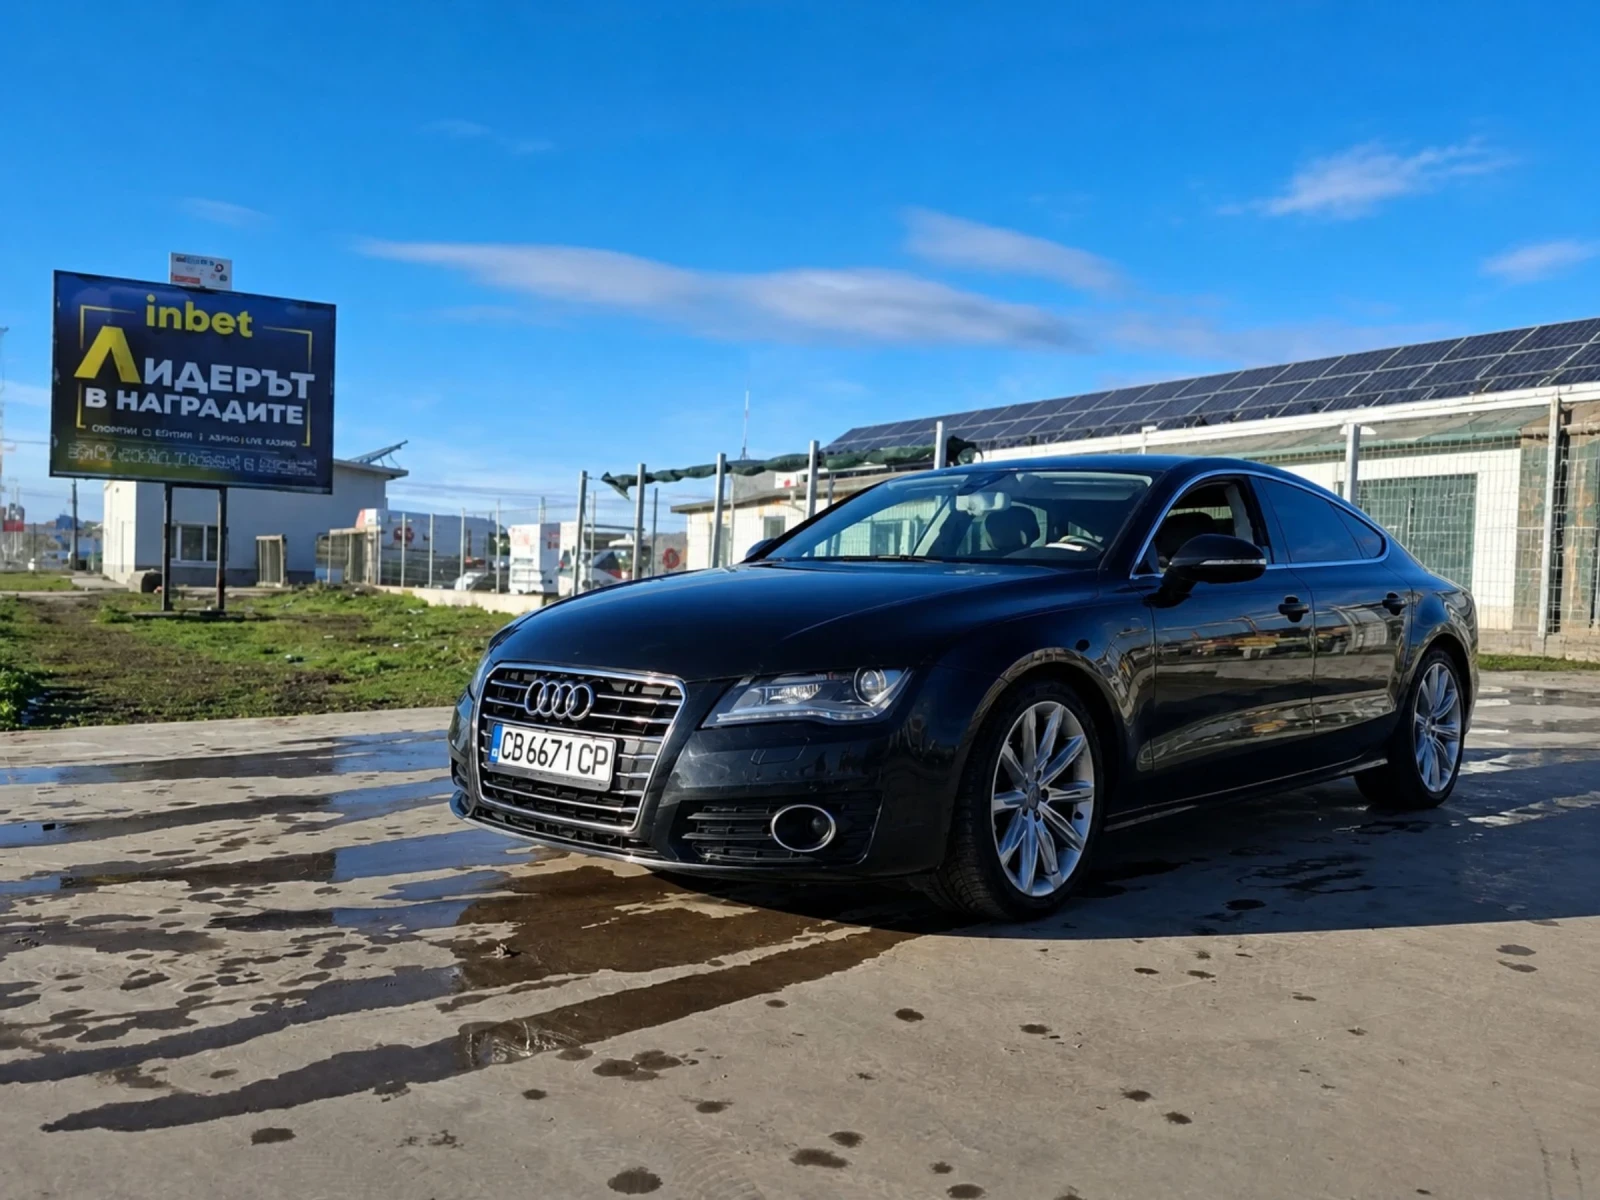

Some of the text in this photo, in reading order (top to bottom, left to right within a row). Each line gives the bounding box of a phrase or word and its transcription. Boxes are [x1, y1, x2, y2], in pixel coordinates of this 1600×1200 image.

[146, 294, 253, 338] inbet
[73, 325, 316, 400] ЛИДЕРЪТ
[85, 387, 304, 425] В НАГРАДИТЕ
[502, 731, 609, 775] CB 6671 CP
